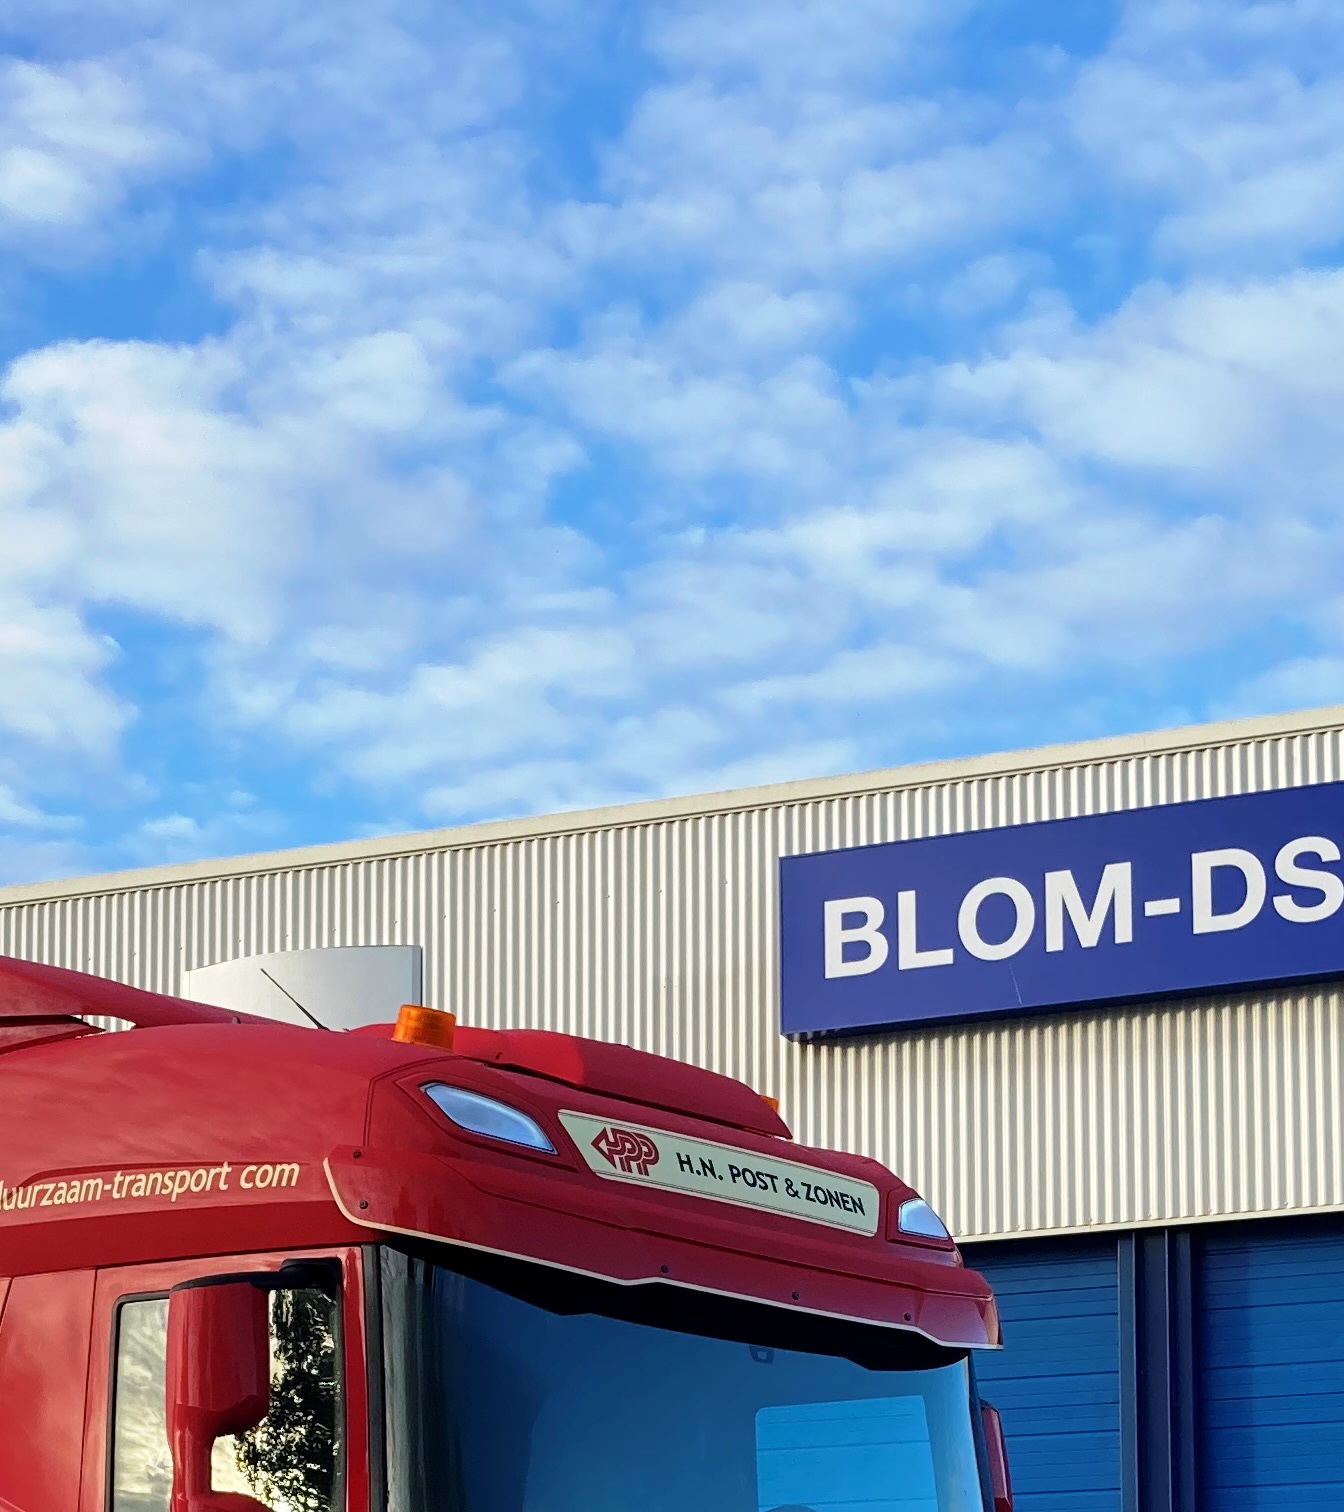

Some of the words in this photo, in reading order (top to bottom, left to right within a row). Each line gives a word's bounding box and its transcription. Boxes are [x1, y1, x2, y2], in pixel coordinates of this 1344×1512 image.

[676, 1152, 724, 1181] H.N.
[728, 1163, 778, 1194] POST
[785, 1178, 801, 1199] &
[801, 1182, 866, 1216] ZONEN
